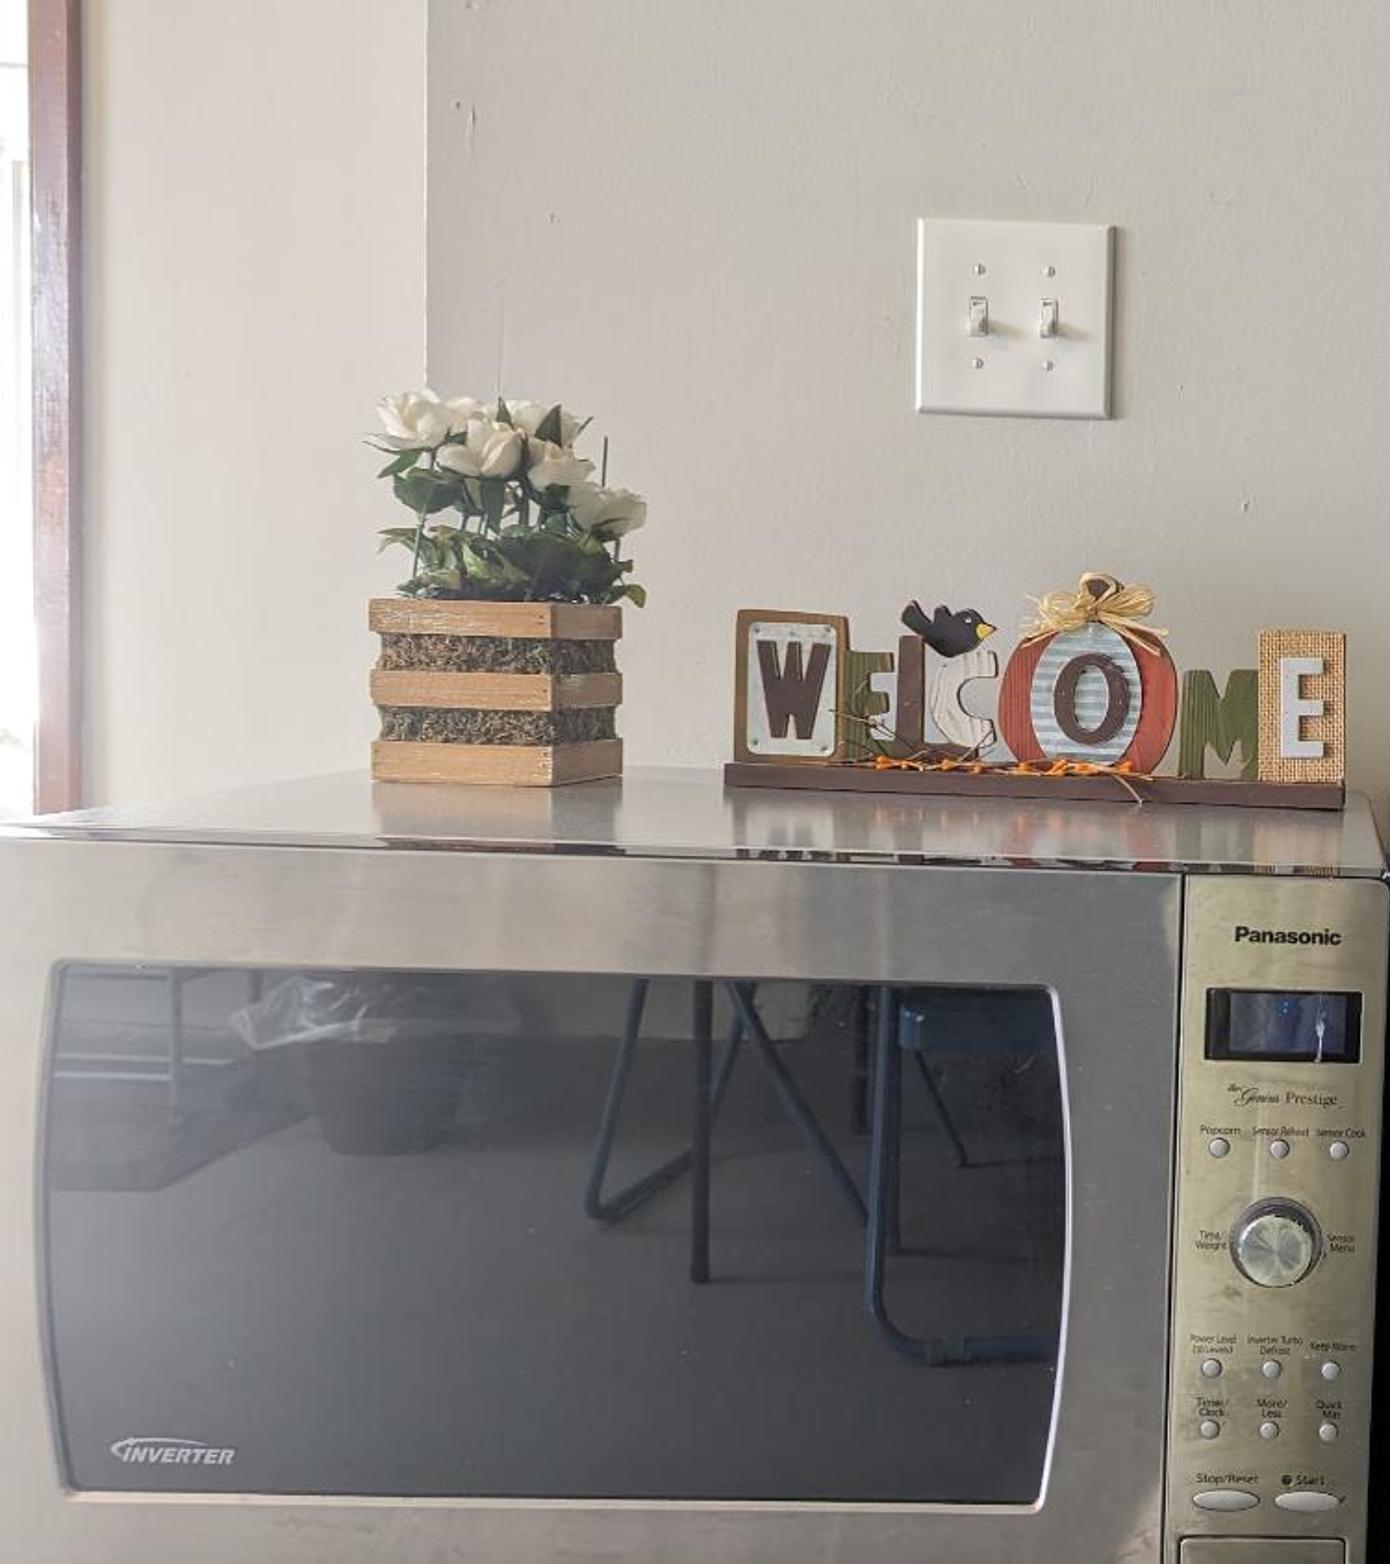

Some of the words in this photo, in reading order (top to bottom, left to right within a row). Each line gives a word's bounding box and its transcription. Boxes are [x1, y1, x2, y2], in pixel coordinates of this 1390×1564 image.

[756, 634, 1326, 779] WELCOME
[1234, 926, 1342, 946] Panasonic
[1285, 1092, 1339, 1109] Prestige
[1200, 1124, 1241, 1136] Popcorn
[122, 1446, 236, 1465] INVERTER
[1196, 1472, 1259, 1485] Stop/Reset
[1296, 1474, 1326, 1486] Start
